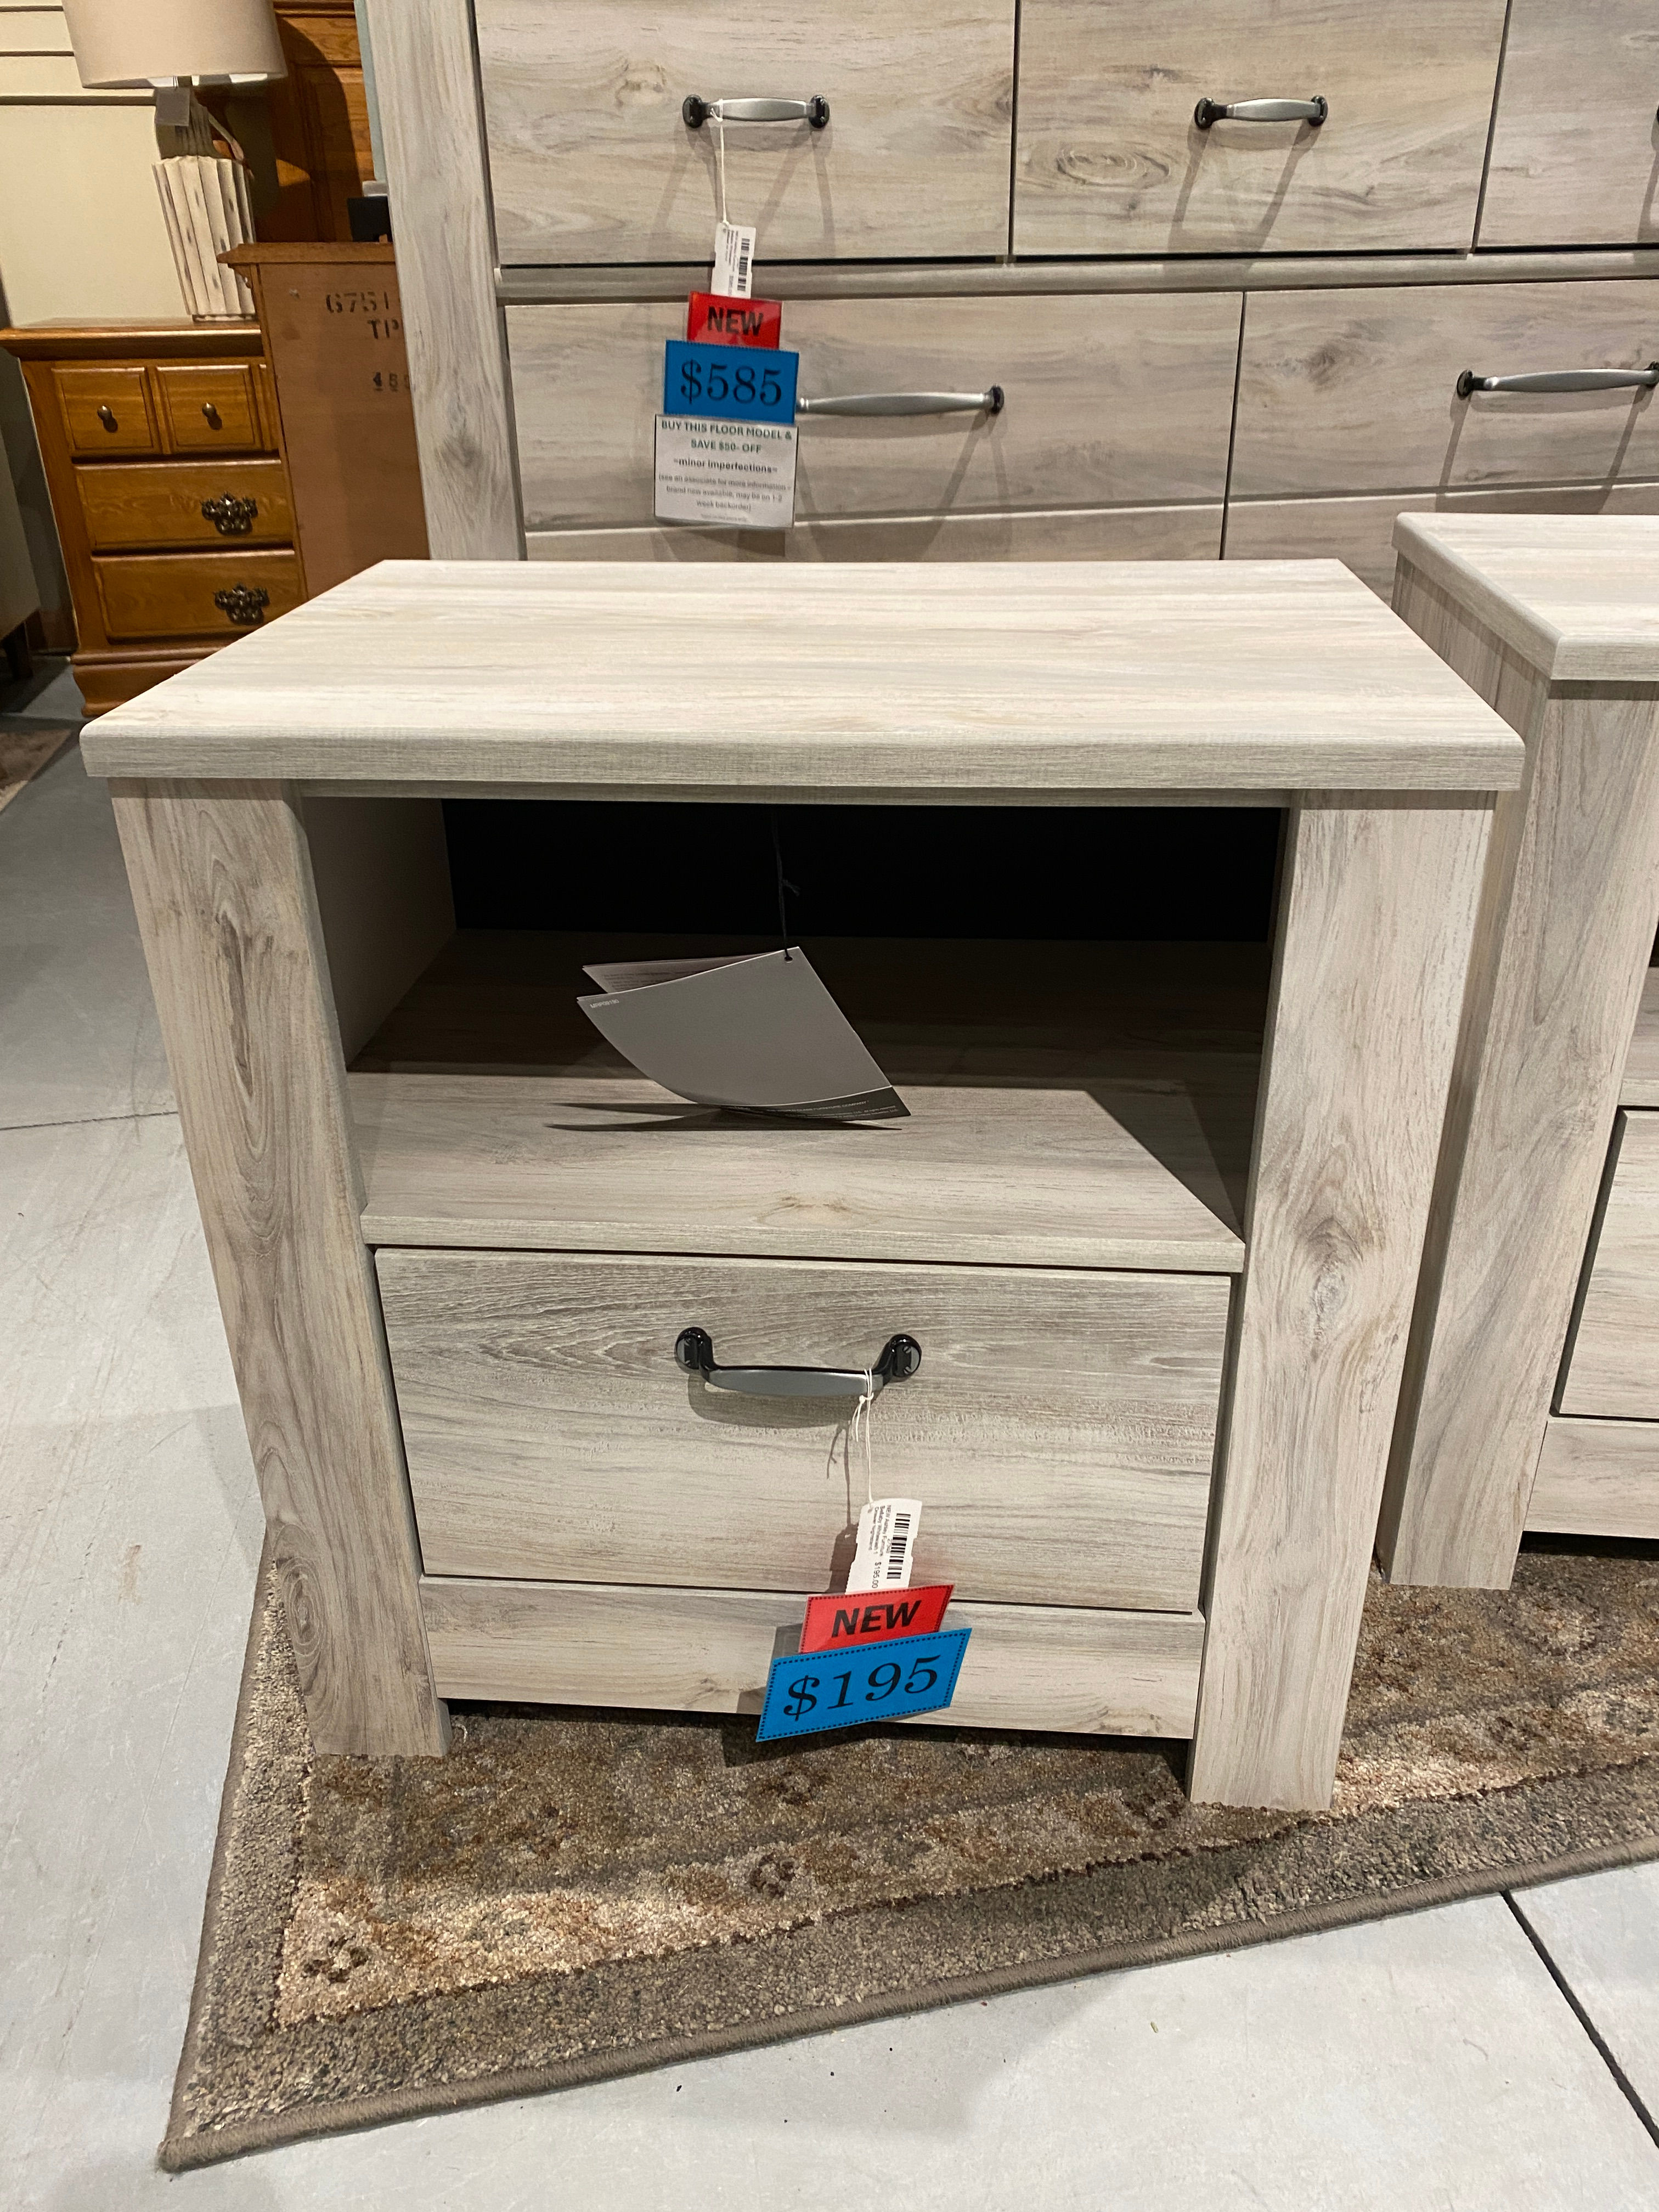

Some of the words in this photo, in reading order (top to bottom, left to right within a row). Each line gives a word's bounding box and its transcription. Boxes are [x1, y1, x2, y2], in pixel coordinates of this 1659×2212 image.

[708, 306, 764, 337] NEW
[680, 358, 782, 407] $585
[662, 420, 681, 430] BUY
[684, 421, 707, 432] THIS
[710, 423, 744, 436] FLOOR
[746, 427, 781, 439] MODEL
[785, 431, 792, 440] &
[691, 439, 716, 450] SAVE
[742, 443, 761, 454] OFF
[872, 1562, 882, 1589] $195.00
[832, 1600, 921, 1638] NEW
[783, 1655, 941, 1721] $195
